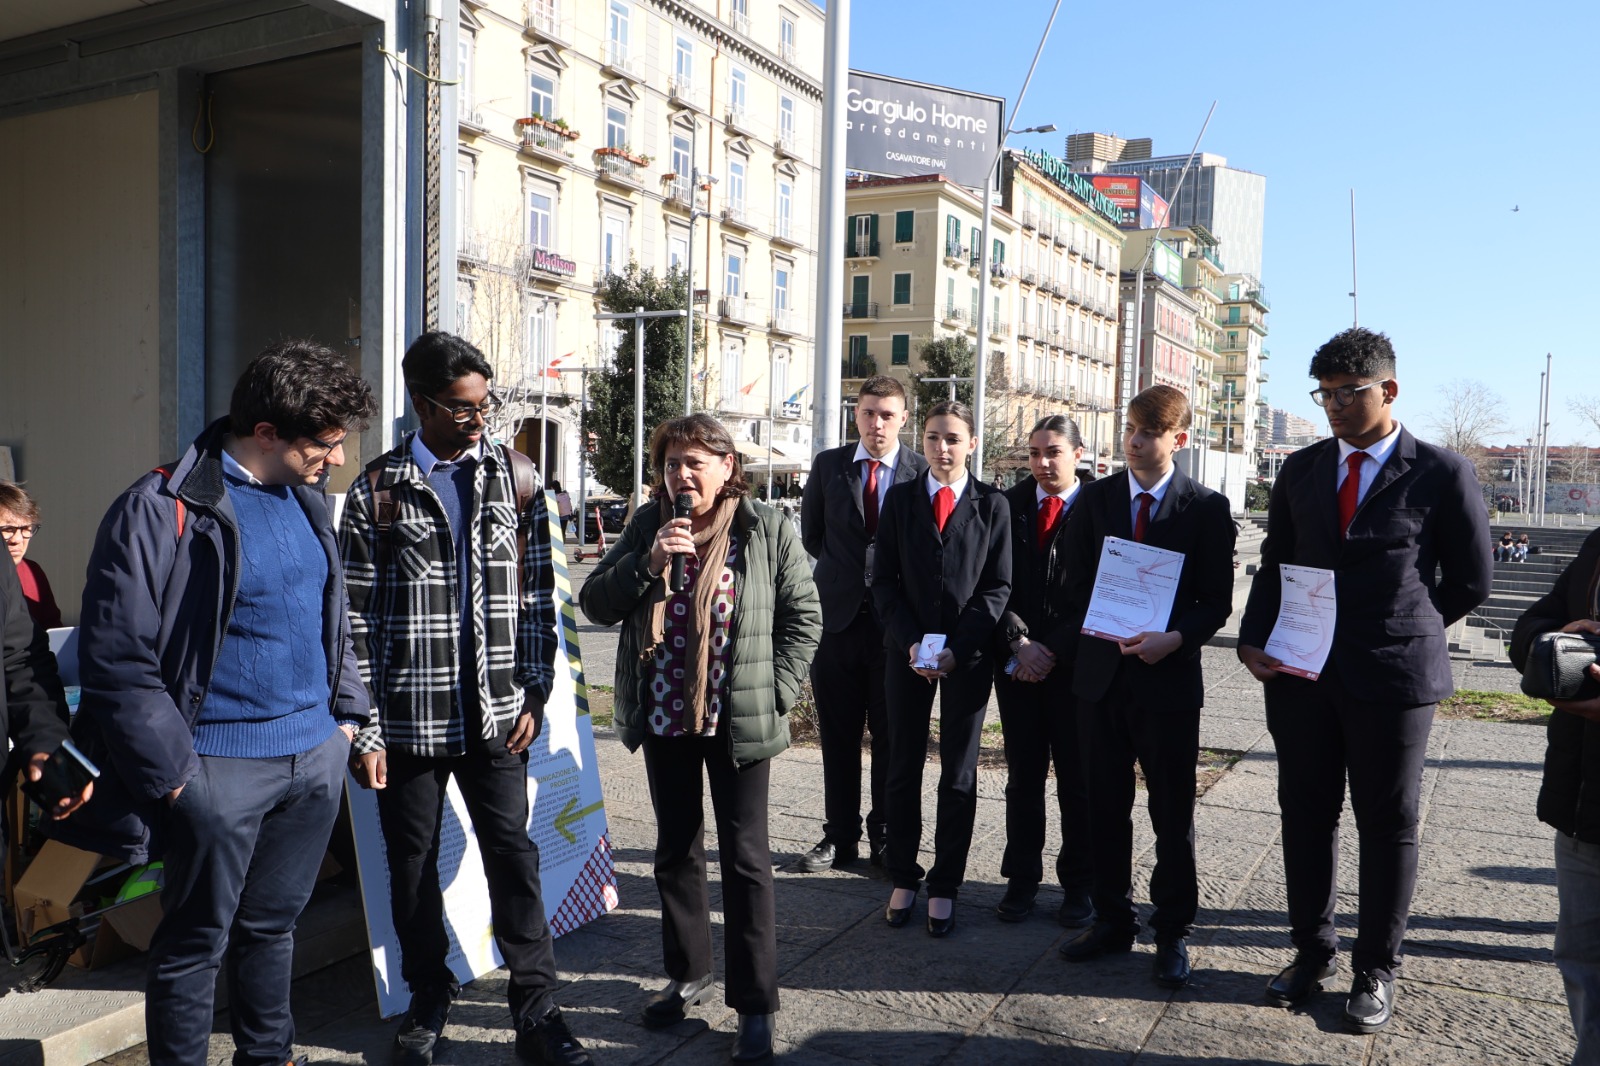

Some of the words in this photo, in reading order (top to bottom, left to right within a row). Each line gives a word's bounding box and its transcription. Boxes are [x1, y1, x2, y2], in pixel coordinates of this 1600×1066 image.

[847, 88, 927, 125] Gargiulo
[932, 103, 987, 134] Home
[846, 120, 985, 152] arredamenti
[885, 151, 931, 167] CASAVATORE
[931, 159, 946, 170] (NA)
[1041, 149, 1072, 189] HOTEL
[535, 250, 575, 272] Madison
[550, 775, 579, 789] PROGETTO
